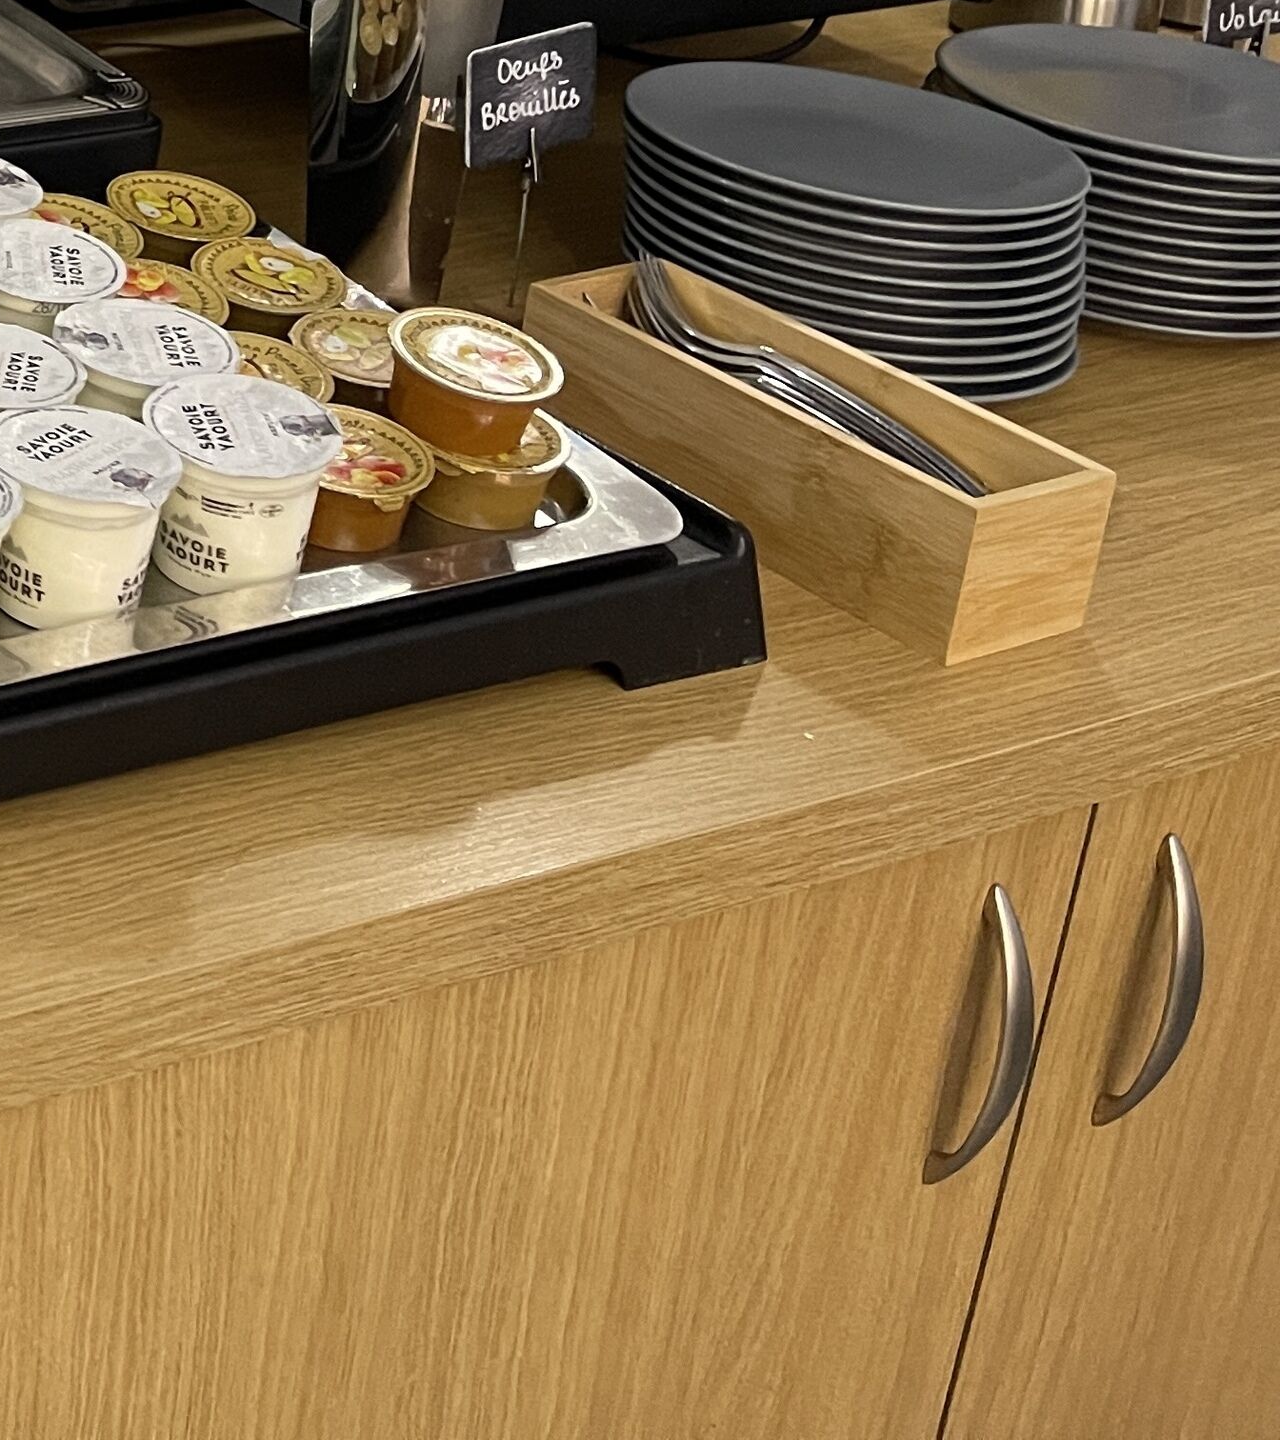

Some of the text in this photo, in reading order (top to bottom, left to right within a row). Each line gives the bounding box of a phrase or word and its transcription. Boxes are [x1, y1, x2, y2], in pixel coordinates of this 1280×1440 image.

[497, 50, 563, 84] Oeufs
[49, 245, 67, 286] YAOURT
[66, 248, 85, 286] SAVOIE
[154, 323, 184, 368] YAOURT
[172, 325, 201, 368] SAVOIE
[2, 352, 25, 392] YAOURT
[20, 355, 43, 393] SAVOIE
[15, 423, 78, 455] SAVOIE
[27, 429, 94, 463] YAOURT
[182, 404, 216, 451] SAVOIE
[199, 403, 235, 451] YAOURT
[159, 534, 230, 575] YAOURT
[160, 520, 227, 561] SAVOIE
